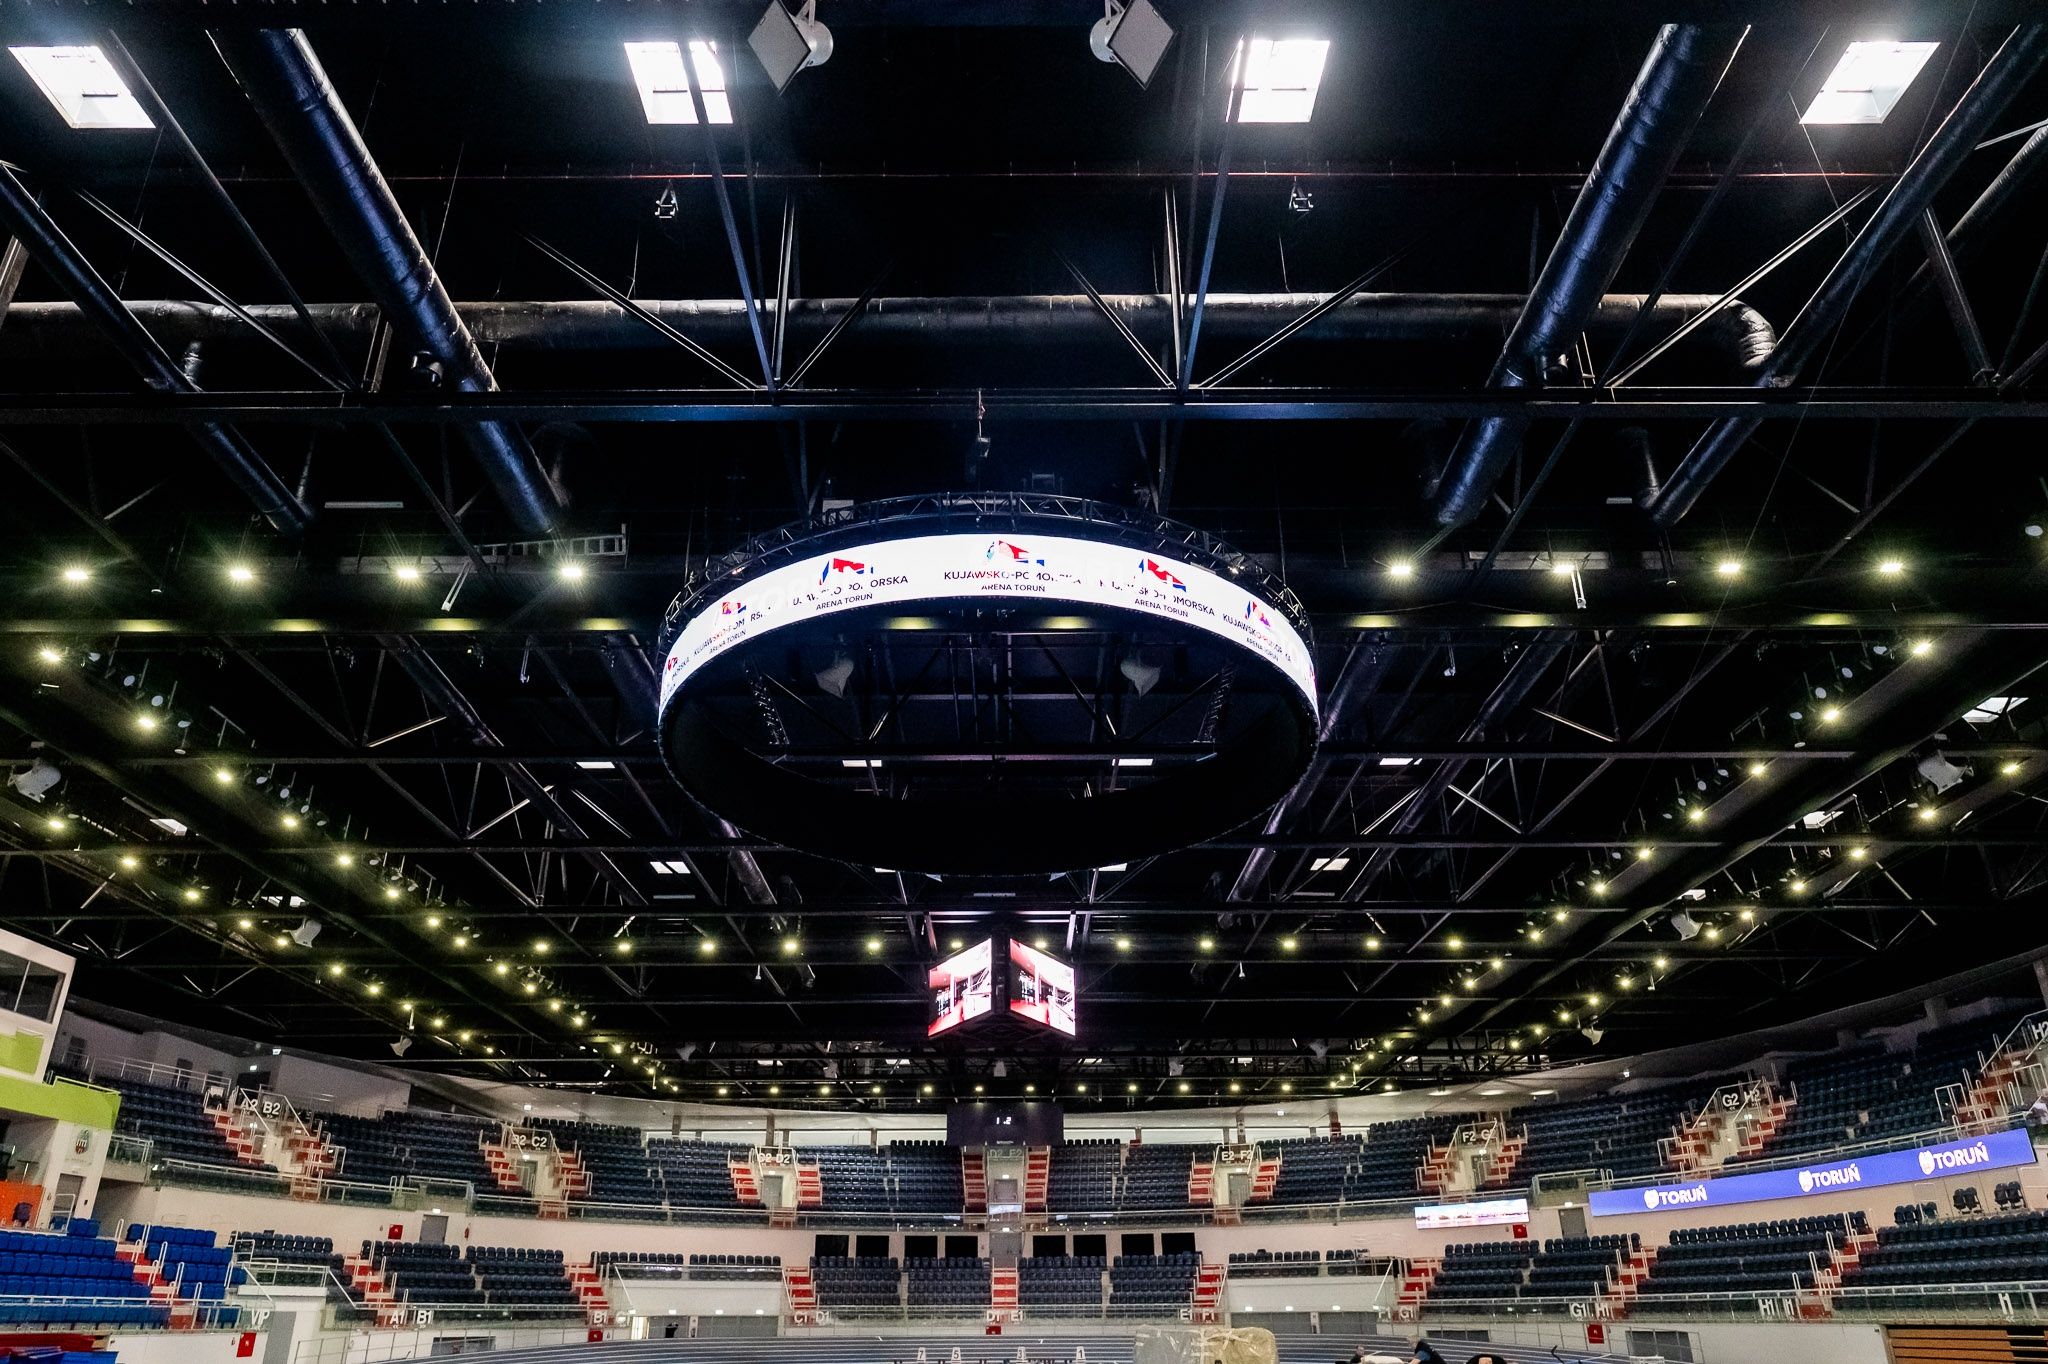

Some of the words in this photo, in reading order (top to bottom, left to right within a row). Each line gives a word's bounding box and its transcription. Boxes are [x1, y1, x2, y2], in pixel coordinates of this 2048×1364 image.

[981, 583, 1012, 591] ARENA
[816, 598, 843, 611] ARENA
[1134, 598, 1161, 611] ARENA
[1722, 1092, 1740, 1107] G2
[263, 1101, 281, 1115] B2
[532, 1136, 547, 1147] C2
[1462, 1131, 1476, 1142] F2
[776, 1153, 791, 1164] D2
[1221, 1151, 1235, 1161] E2
[1932, 1141, 1989, 1169] TORUŃ
[1811, 1163, 1861, 1188] TORUŃ
[1658, 1184, 1708, 1206] TORUŃ
[1571, 1302, 1587, 1318] G1
[1758, 1298, 1775, 1316] H1
[251, 1308, 271, 1326] VIP
[389, 1309, 405, 1325] A1
[416, 1310, 432, 1325] B1
[918, 1351, 924, 1359] 7
[953, 1351, 959, 1359] 5
[1018, 1351, 1023, 1359] 3
[1078, 1350, 1083, 1359] 1
